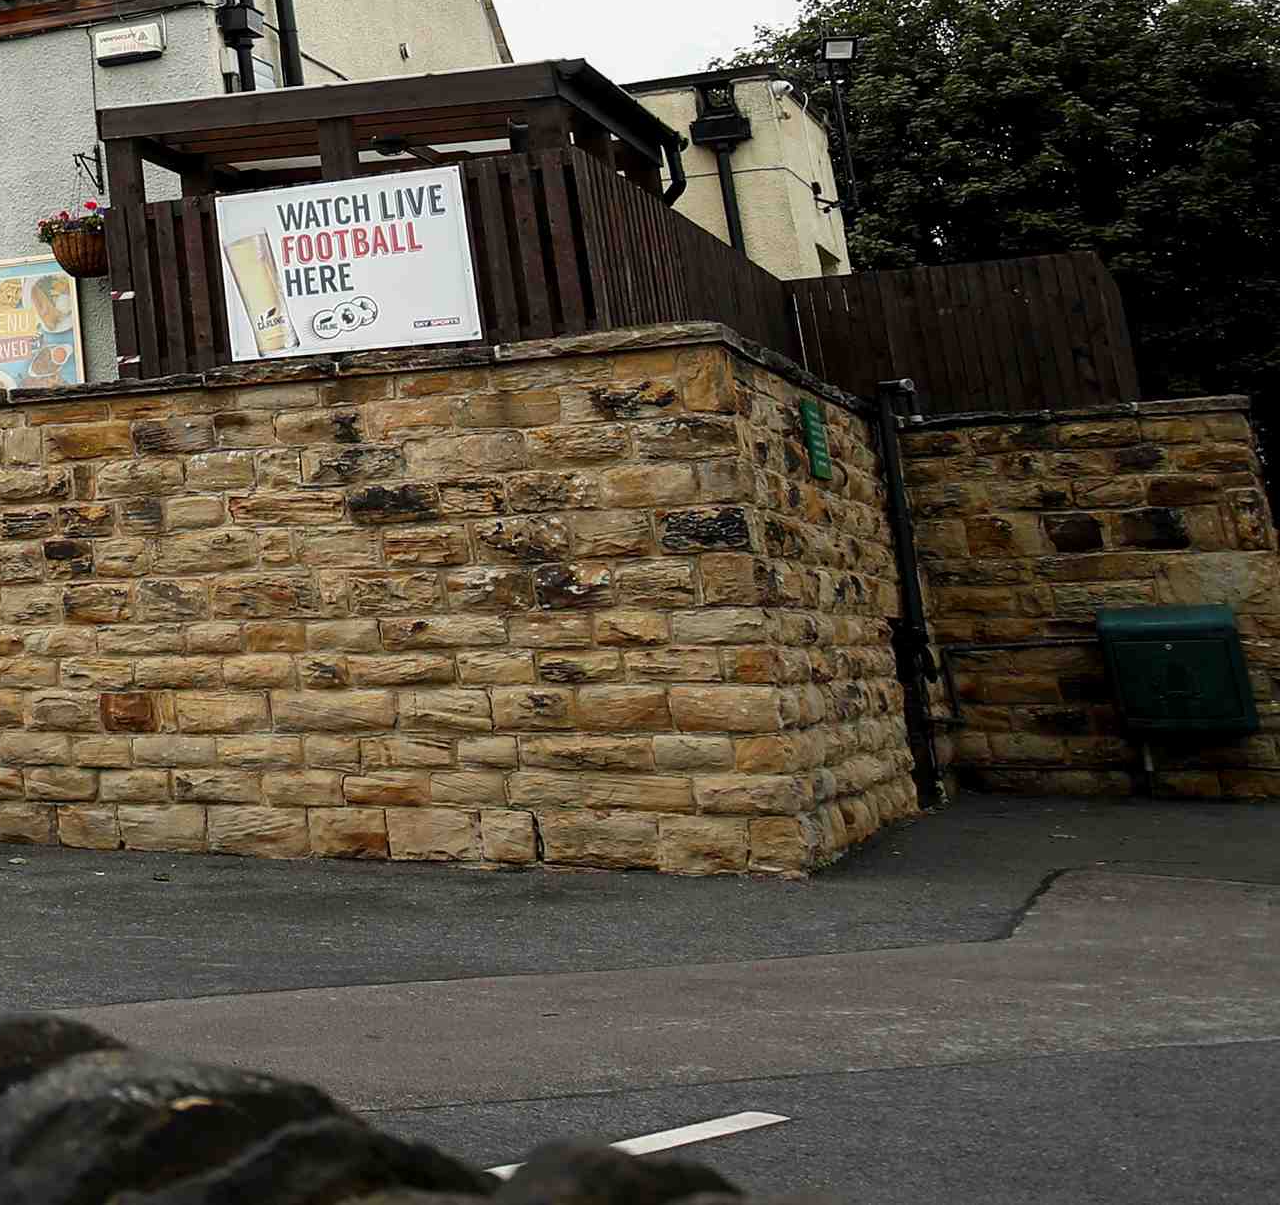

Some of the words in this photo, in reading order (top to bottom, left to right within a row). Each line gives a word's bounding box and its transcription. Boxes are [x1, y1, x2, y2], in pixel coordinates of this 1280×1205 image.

[276, 194, 371, 232] WATCH
[380, 183, 446, 221] LIVE
[281, 221, 423, 267] FOOTBALL
[285, 262, 355, 297] HERE
